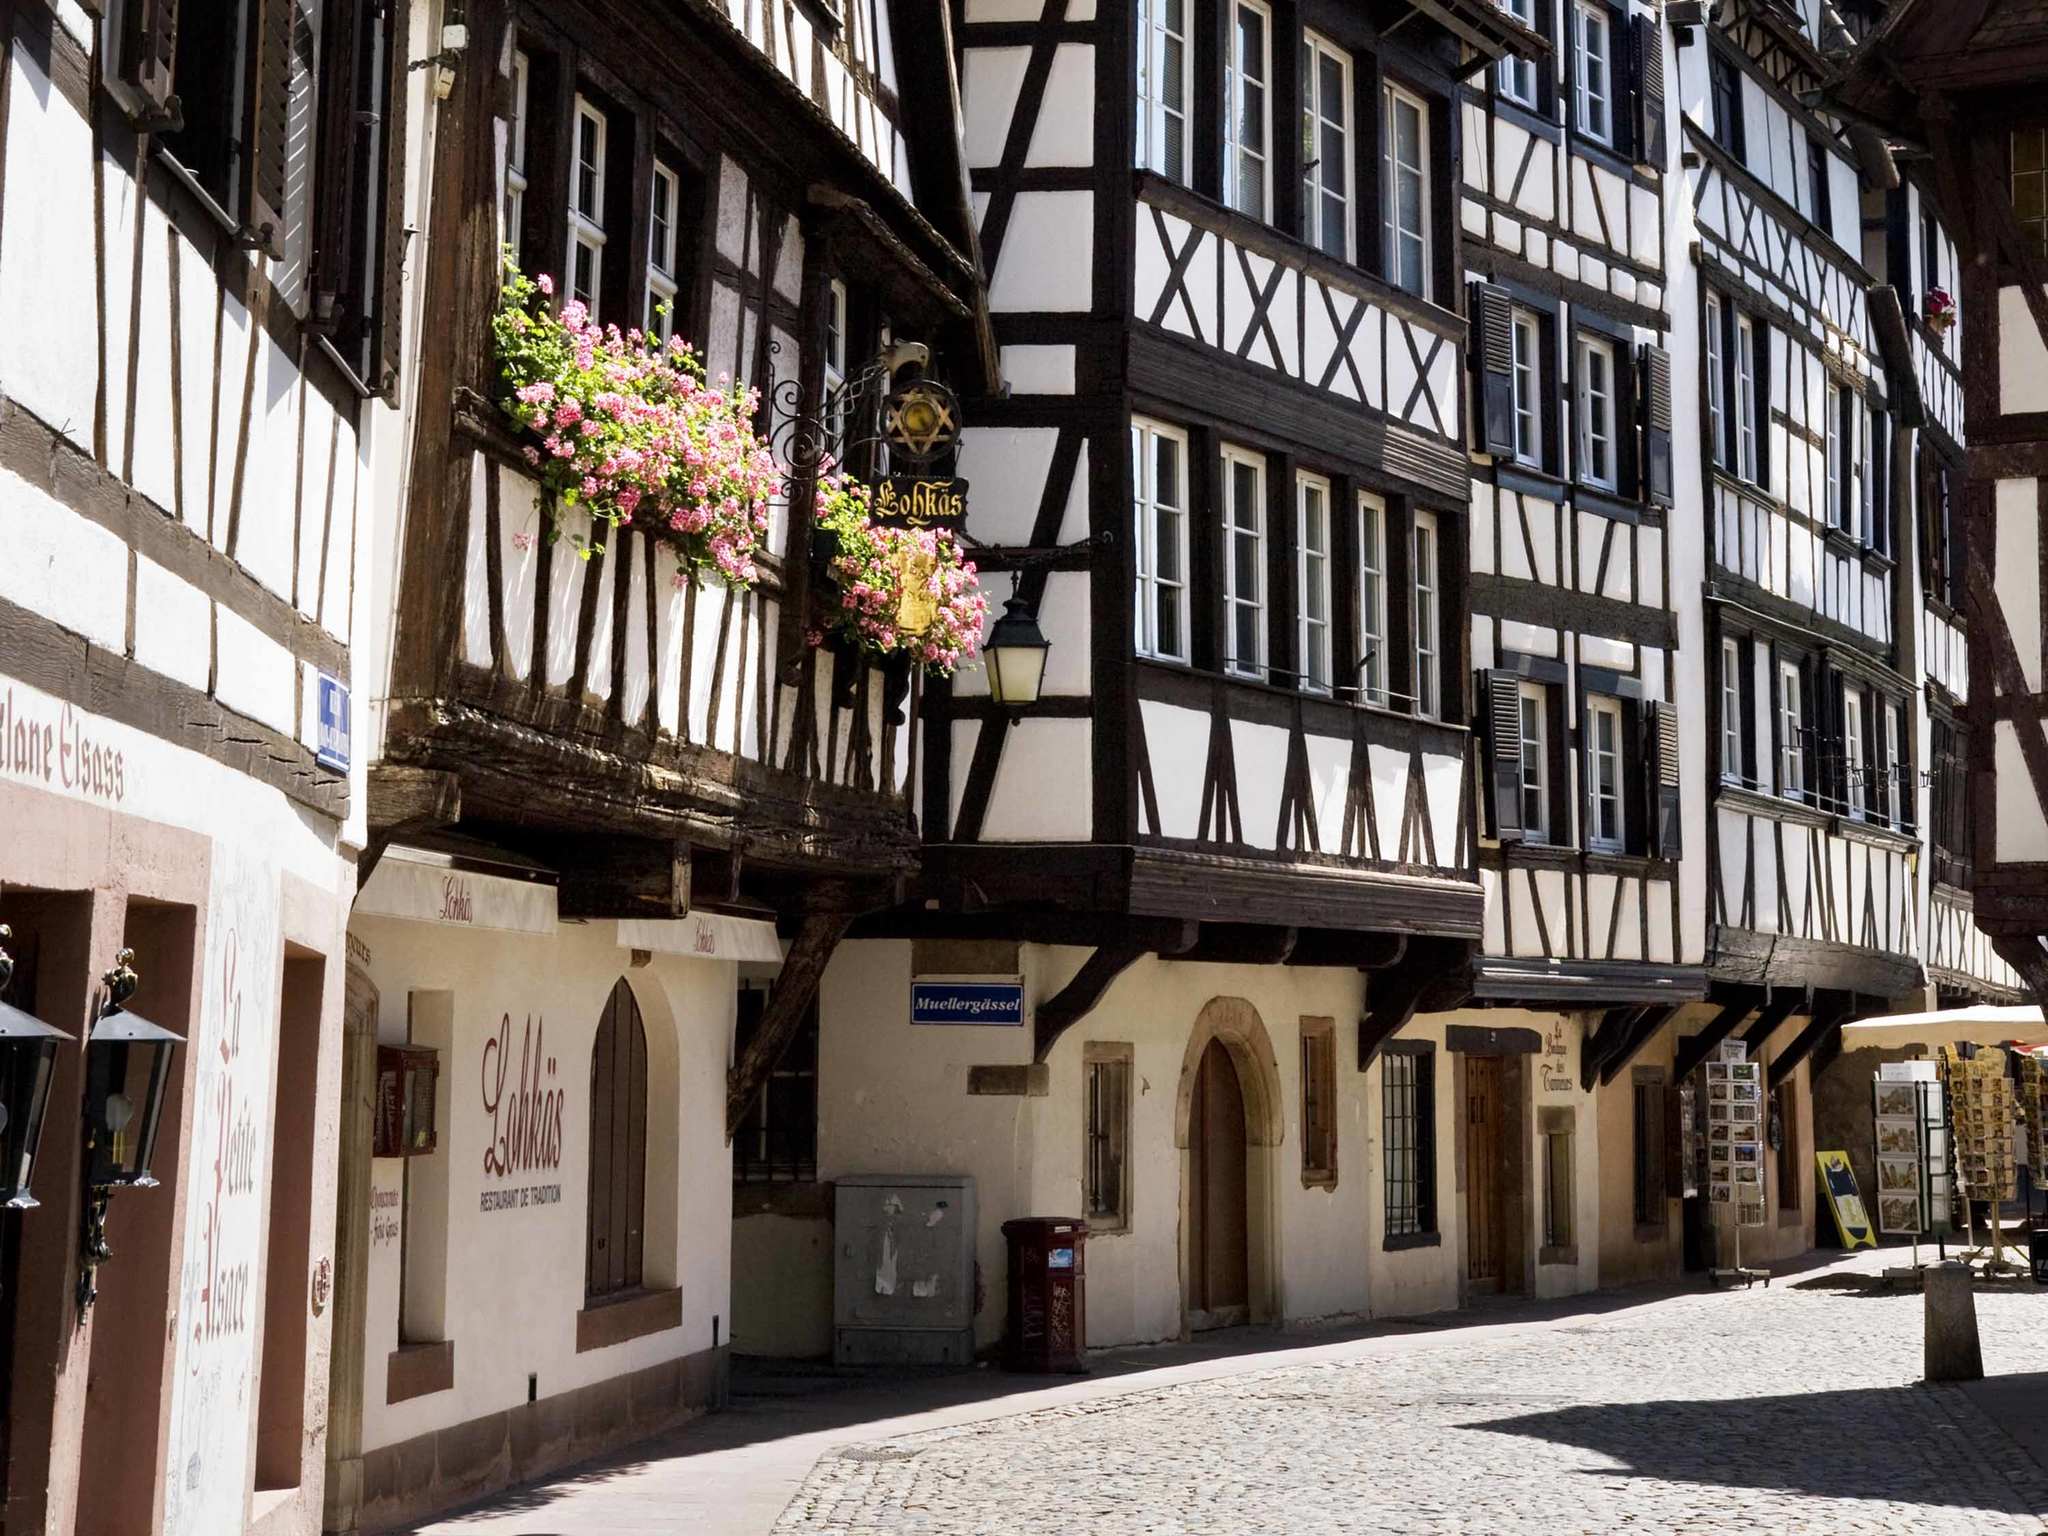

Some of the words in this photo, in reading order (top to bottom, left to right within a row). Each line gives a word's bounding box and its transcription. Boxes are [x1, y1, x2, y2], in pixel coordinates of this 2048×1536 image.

[874, 480, 962, 525] Lohkäs
[60, 700, 123, 802] Elsass
[916, 998, 1020, 1014] Muellergässel
[482, 1012, 563, 1177] Lohkäs
[215, 1072, 256, 1226] Petite
[480, 1188, 517, 1212] RESTAURANT
[520, 1187, 529, 1207] DE
[531, 1184, 561, 1205] TRADITION
[197, 1201, 249, 1342] Alsace
